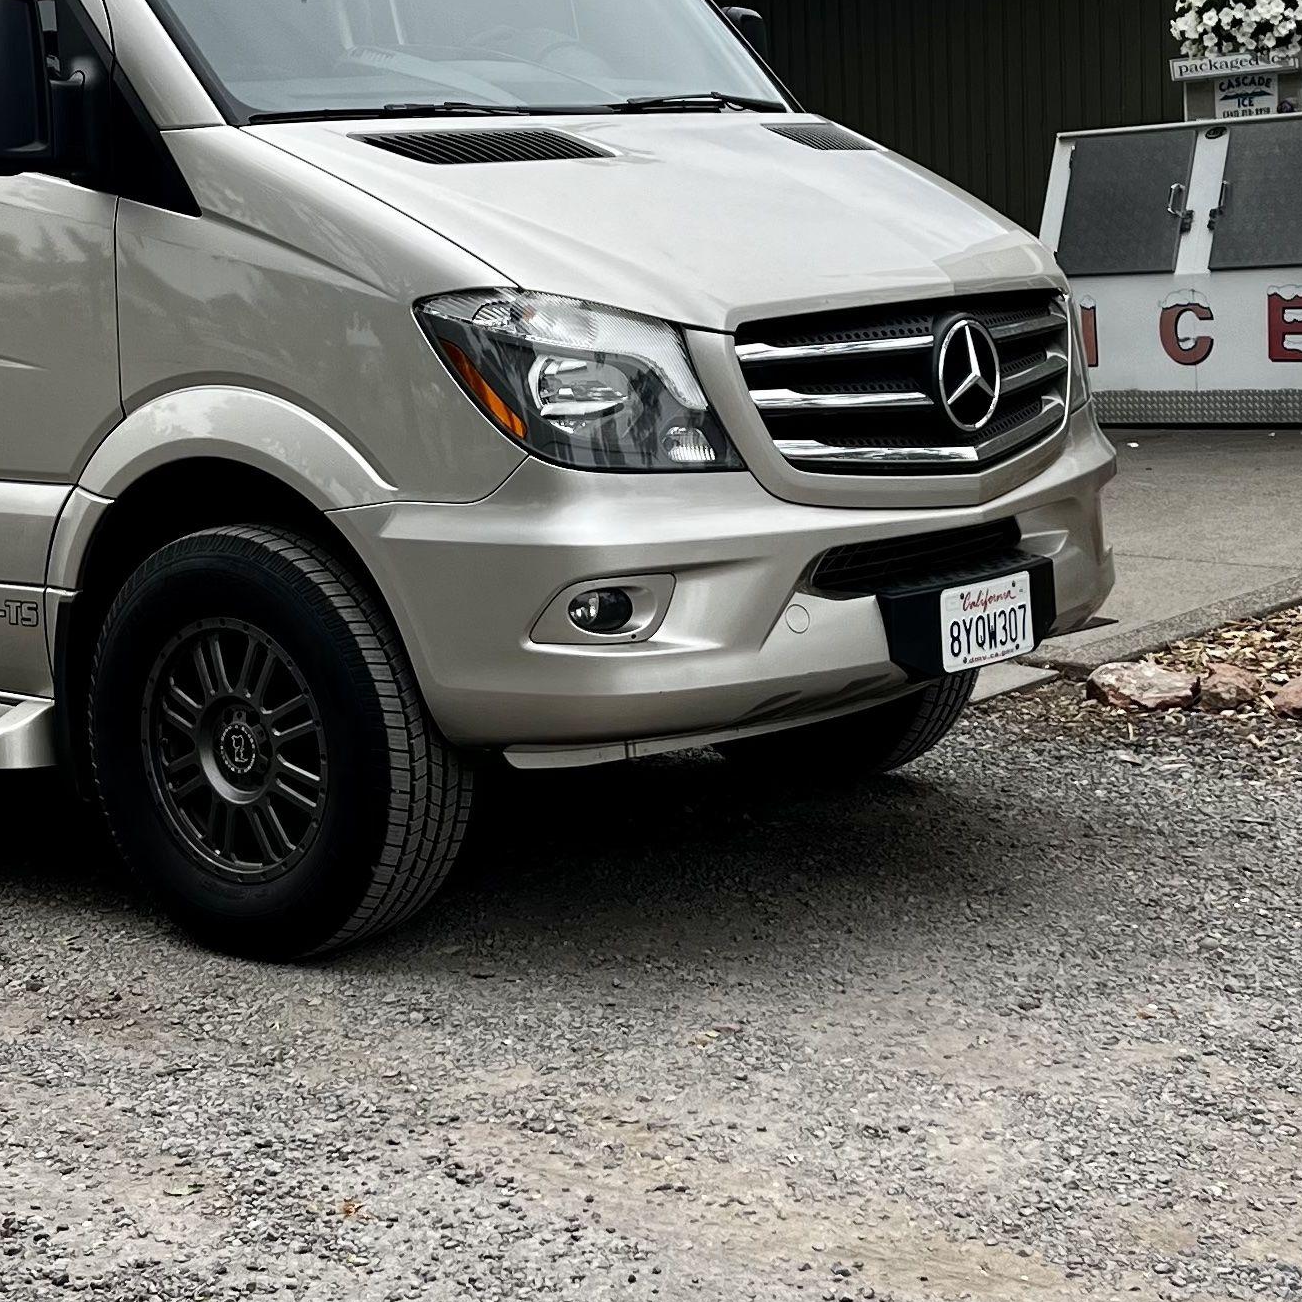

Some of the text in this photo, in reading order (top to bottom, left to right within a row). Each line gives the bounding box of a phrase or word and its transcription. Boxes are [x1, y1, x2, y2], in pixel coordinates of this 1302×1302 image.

[1178, 54, 1260, 77] packaged
[1219, 76, 1272, 92] CASCADE
[1237, 97, 1254, 108] ICE
[963, 588, 1016, 613] California
[950, 604, 1027, 658] 8YQW307
